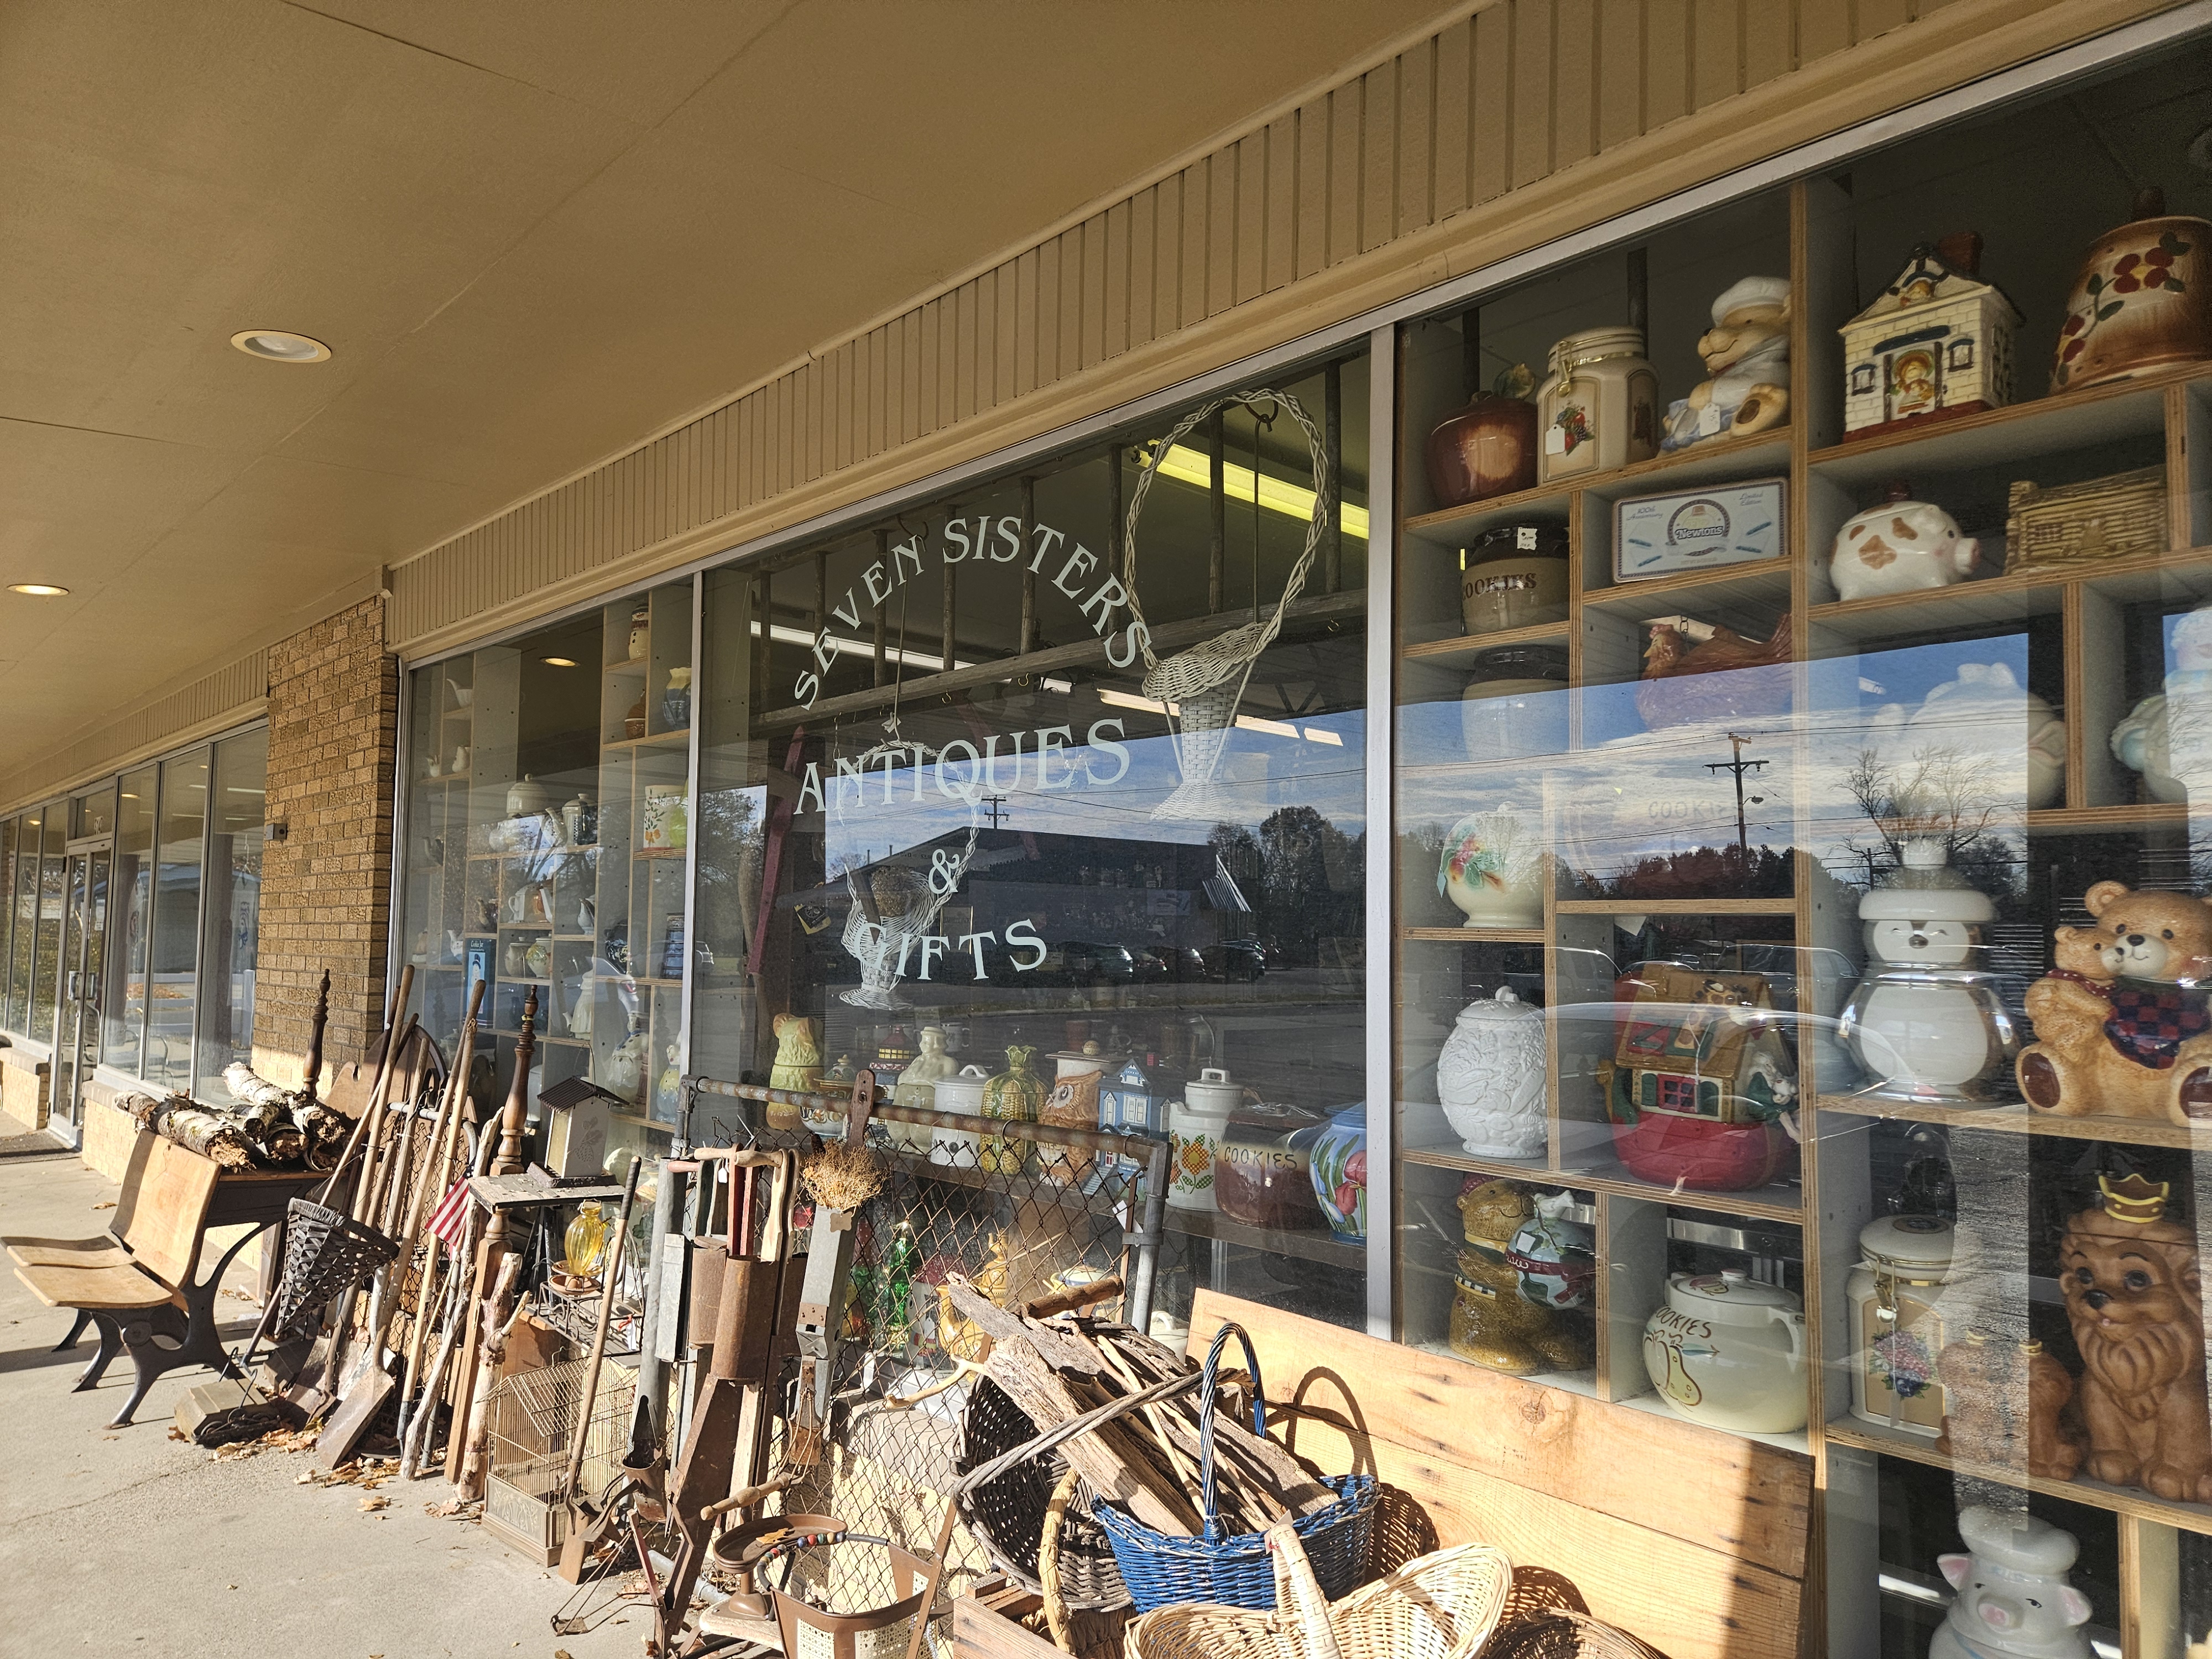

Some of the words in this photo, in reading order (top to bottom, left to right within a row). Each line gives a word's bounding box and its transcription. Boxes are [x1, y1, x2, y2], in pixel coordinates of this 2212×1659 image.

[1675, 525, 1725, 540] Newtons
[794, 534, 925, 710] SEVEN
[943, 515, 1152, 668] SISTERS
[793, 718, 1131, 816] ANTIQUES
[928, 848, 960, 895] &
[853, 919, 1047, 980] GIFTS
[1224, 1146, 1297, 1171] COOKIES
[1656, 1305, 1711, 1339] OOKIES
